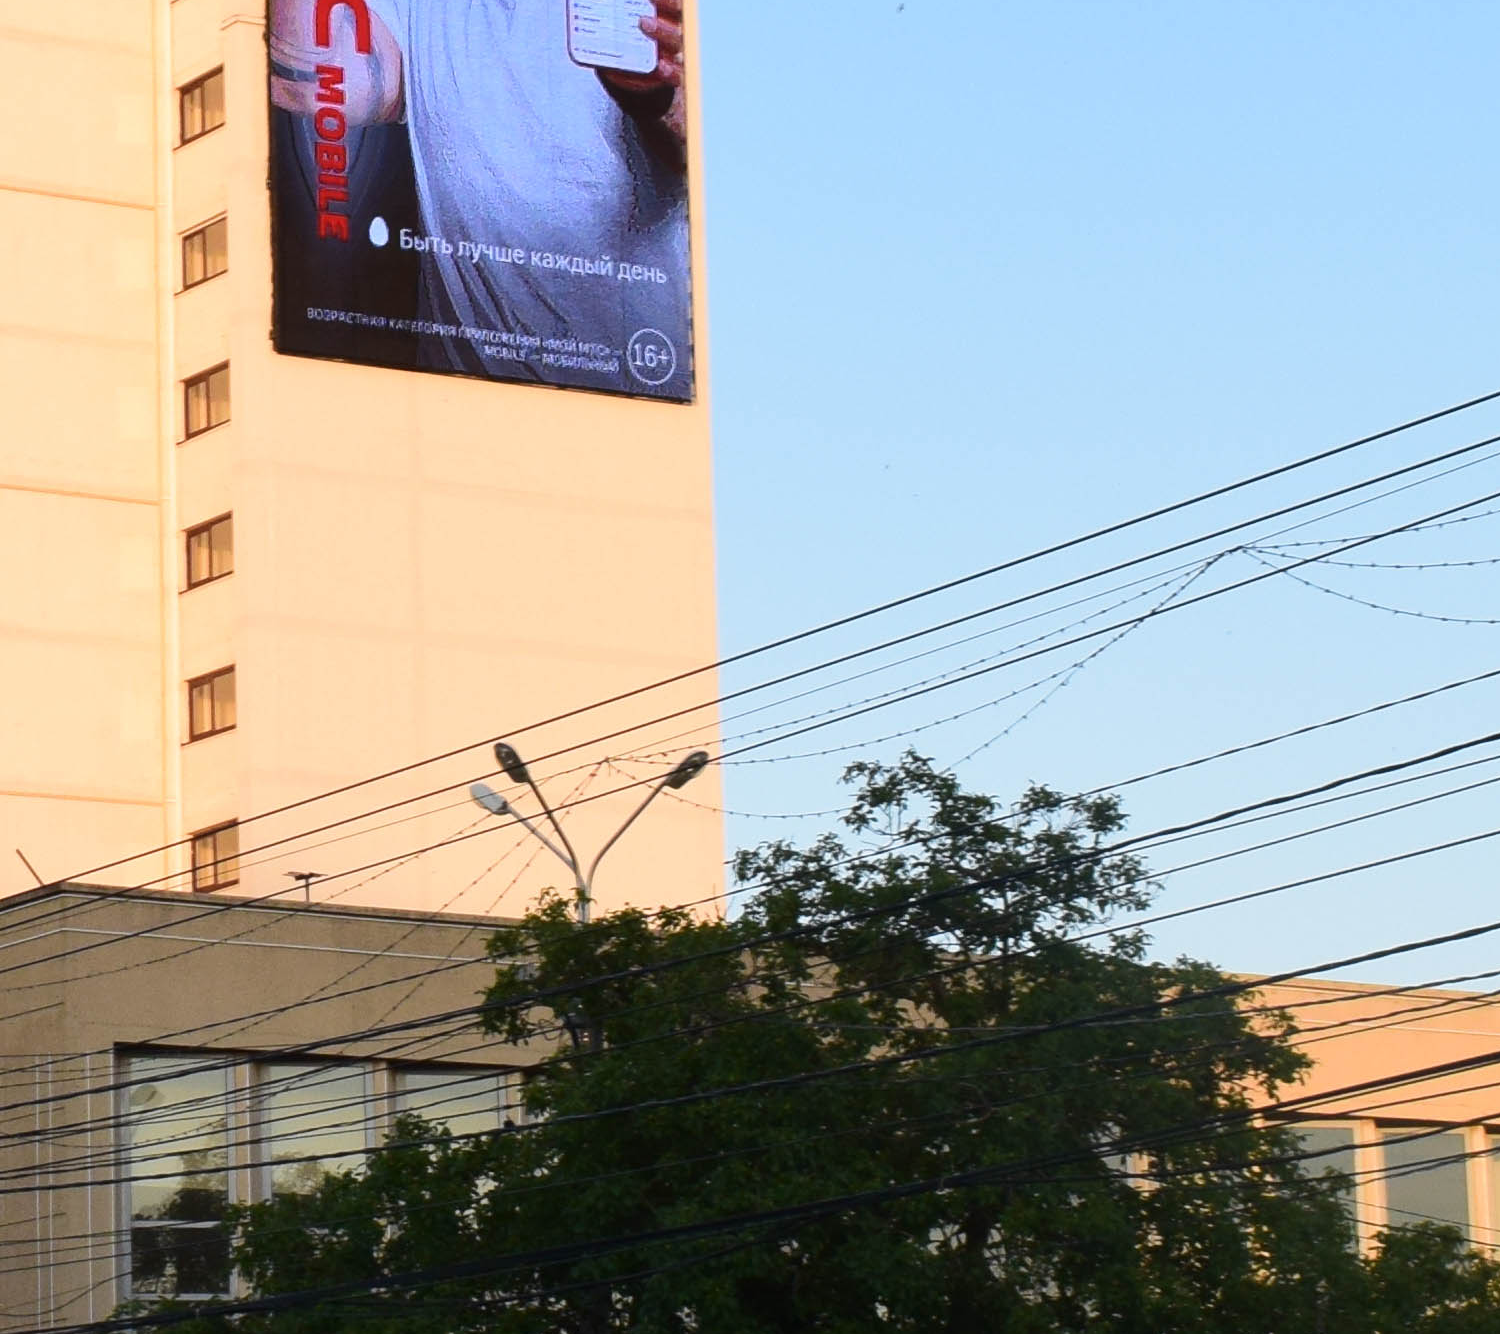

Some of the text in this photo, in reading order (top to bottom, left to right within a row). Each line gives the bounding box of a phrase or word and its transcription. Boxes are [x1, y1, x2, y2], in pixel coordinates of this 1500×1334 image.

[314, 65, 350, 244] MOBILE
[400, 228, 668, 285] Быть лучше каждый день
[632, 343, 670, 370] 16+
